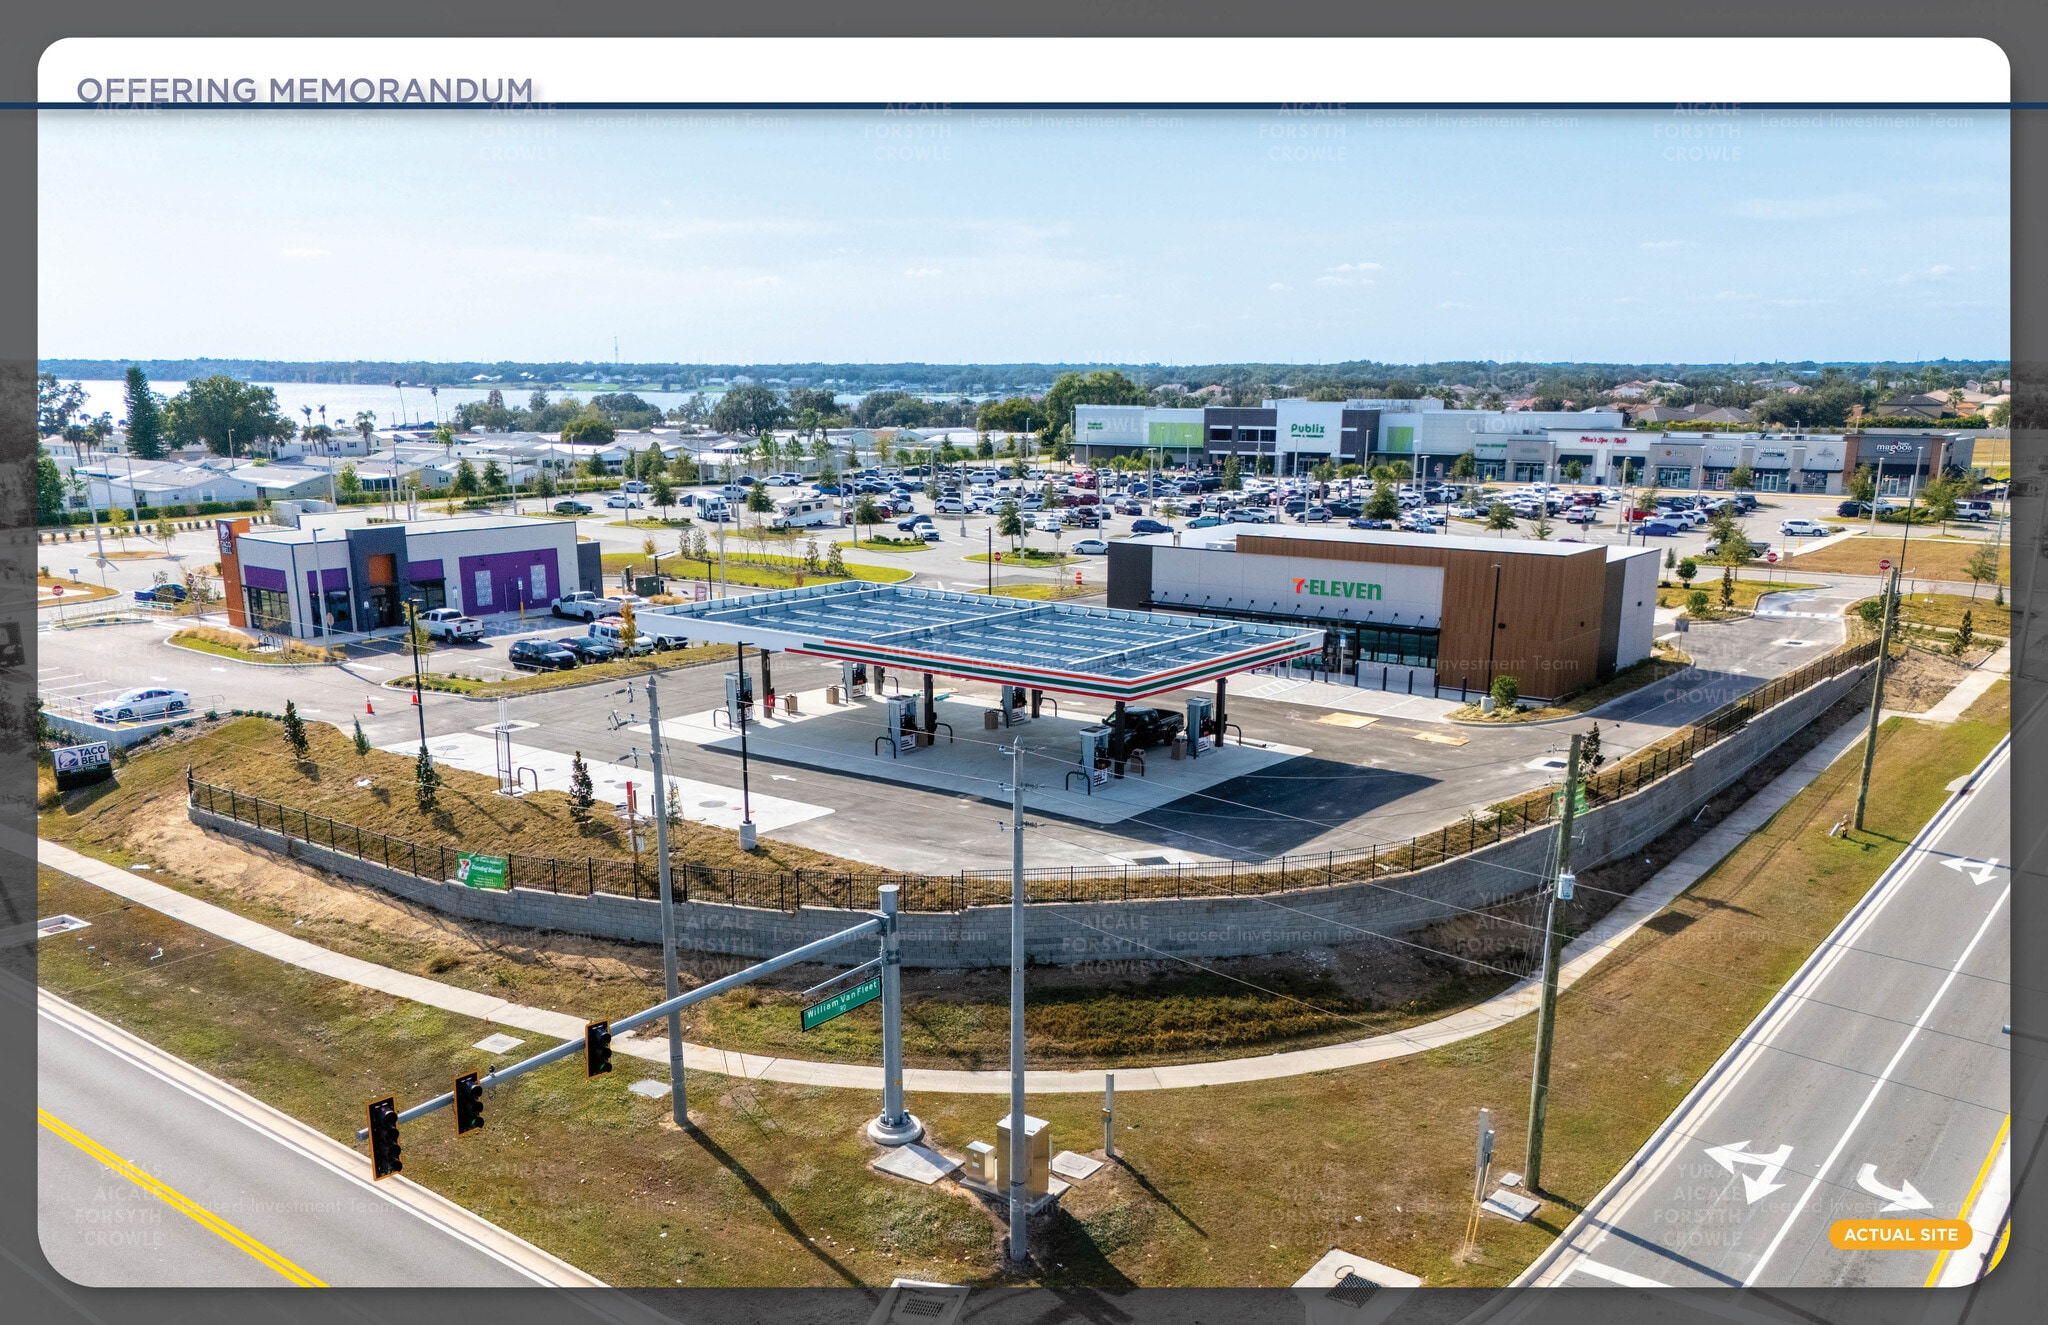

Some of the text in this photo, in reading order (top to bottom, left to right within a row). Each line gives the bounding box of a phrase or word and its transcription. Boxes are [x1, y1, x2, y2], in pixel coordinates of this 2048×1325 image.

[1291, 423, 1325, 434] Publix
[78, 745, 106, 757] TACO
[81, 754, 107, 765] BELL
[807, 999, 839, 1018] William
